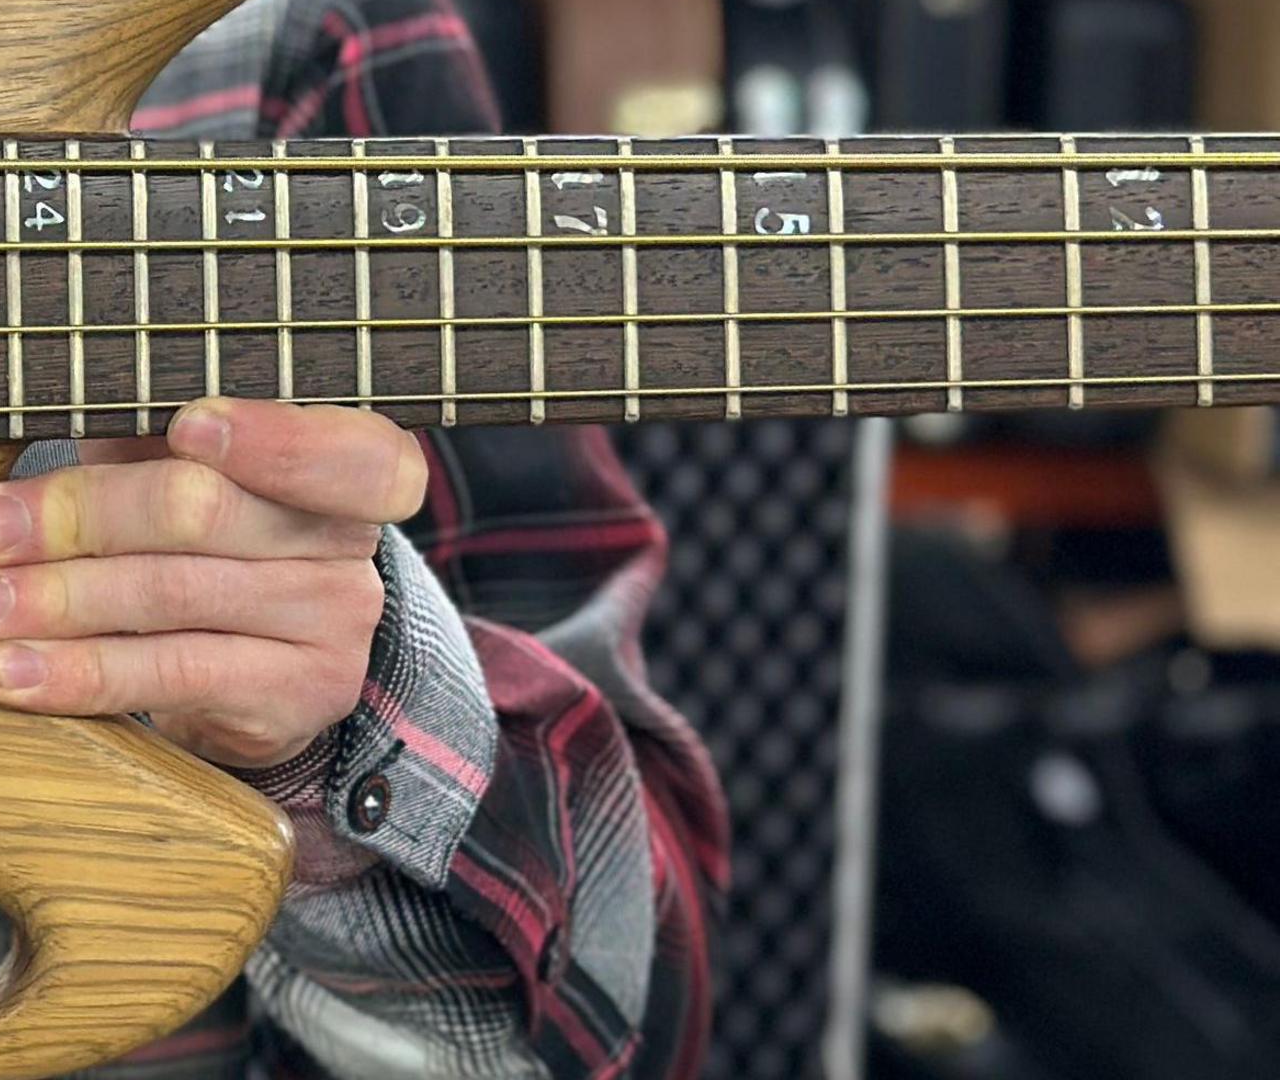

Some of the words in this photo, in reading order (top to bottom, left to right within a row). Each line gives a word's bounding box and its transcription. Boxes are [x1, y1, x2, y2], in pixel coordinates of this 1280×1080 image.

[24, 170, 65, 231] 24
[224, 170, 266, 224] 21
[378, 171, 427, 233] 19
[551, 172, 608, 236] 17
